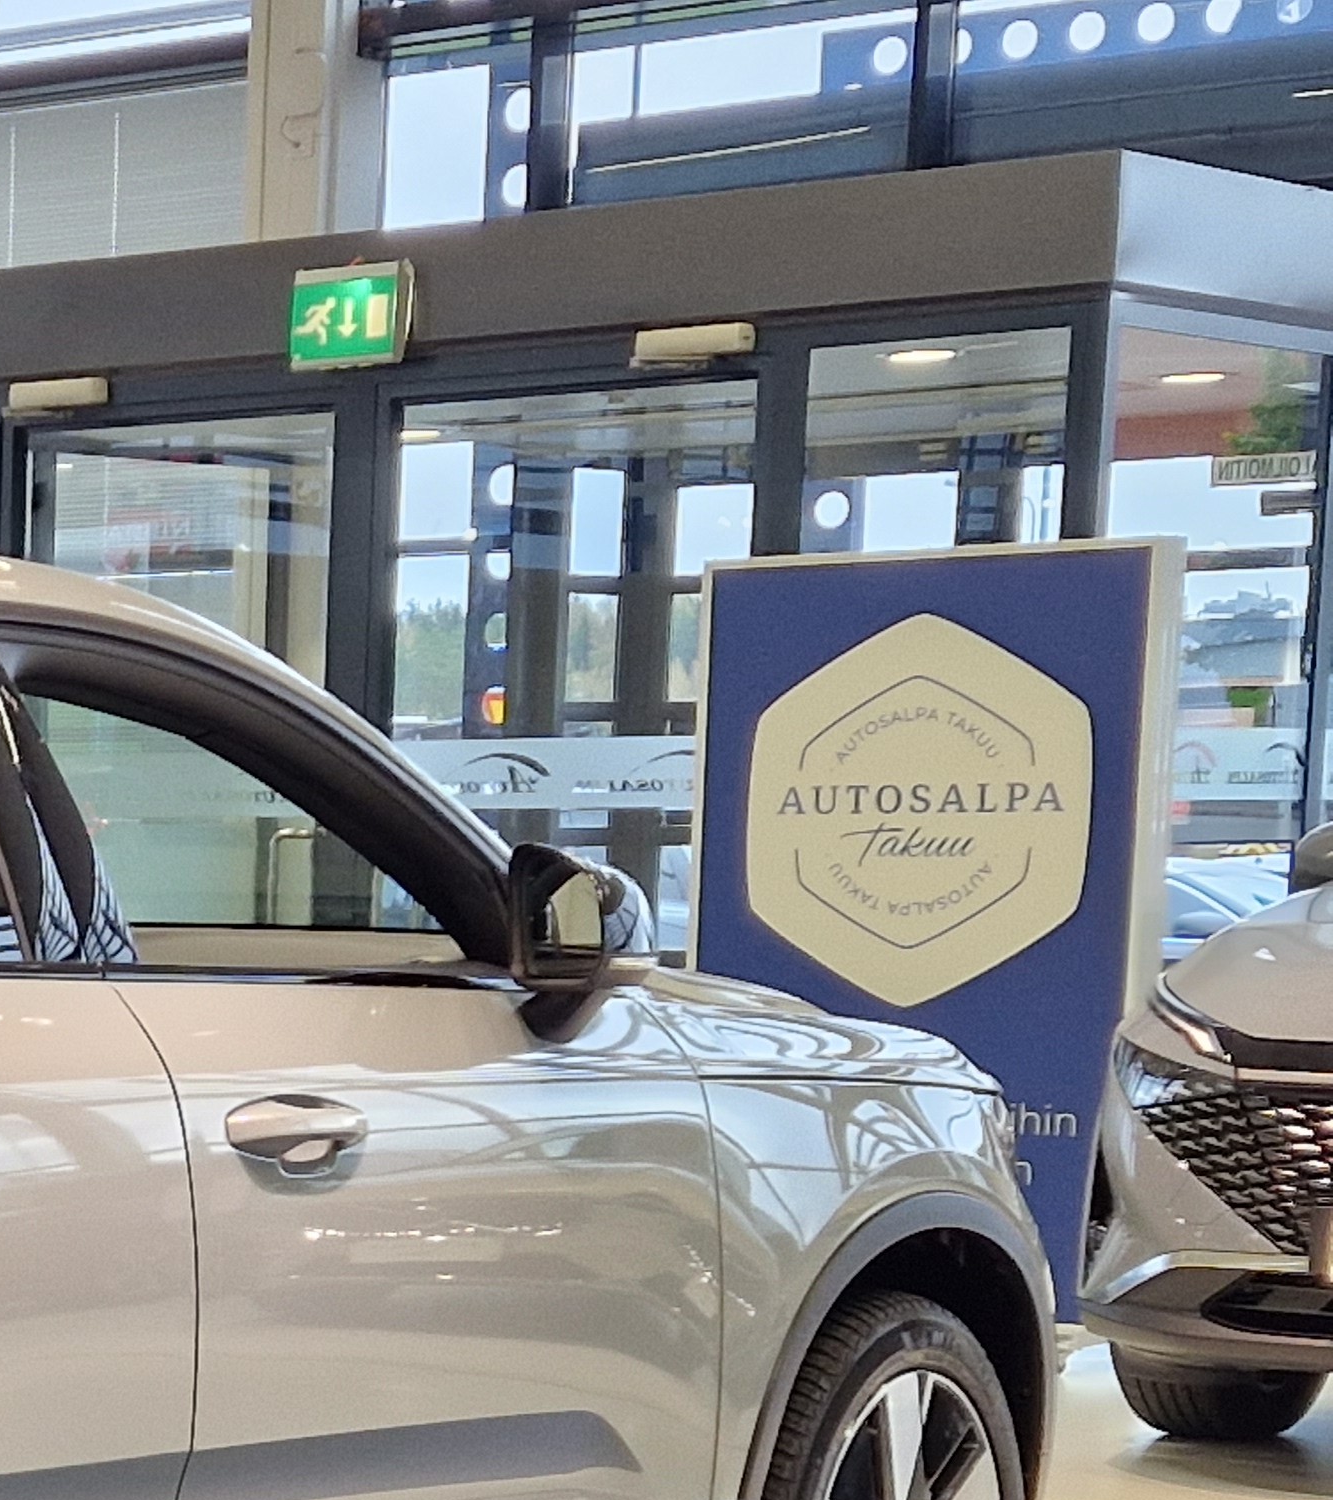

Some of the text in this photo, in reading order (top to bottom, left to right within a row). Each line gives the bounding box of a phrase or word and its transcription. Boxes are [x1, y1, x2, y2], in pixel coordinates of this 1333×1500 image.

[835, 706, 1001, 765] AUTOSALPA TAKUU
[776, 780, 1064, 816] AUTOSALPA
[839, 823, 976, 867] Takuu
[828, 861, 993, 917] AUTOSALPA TAKUU
